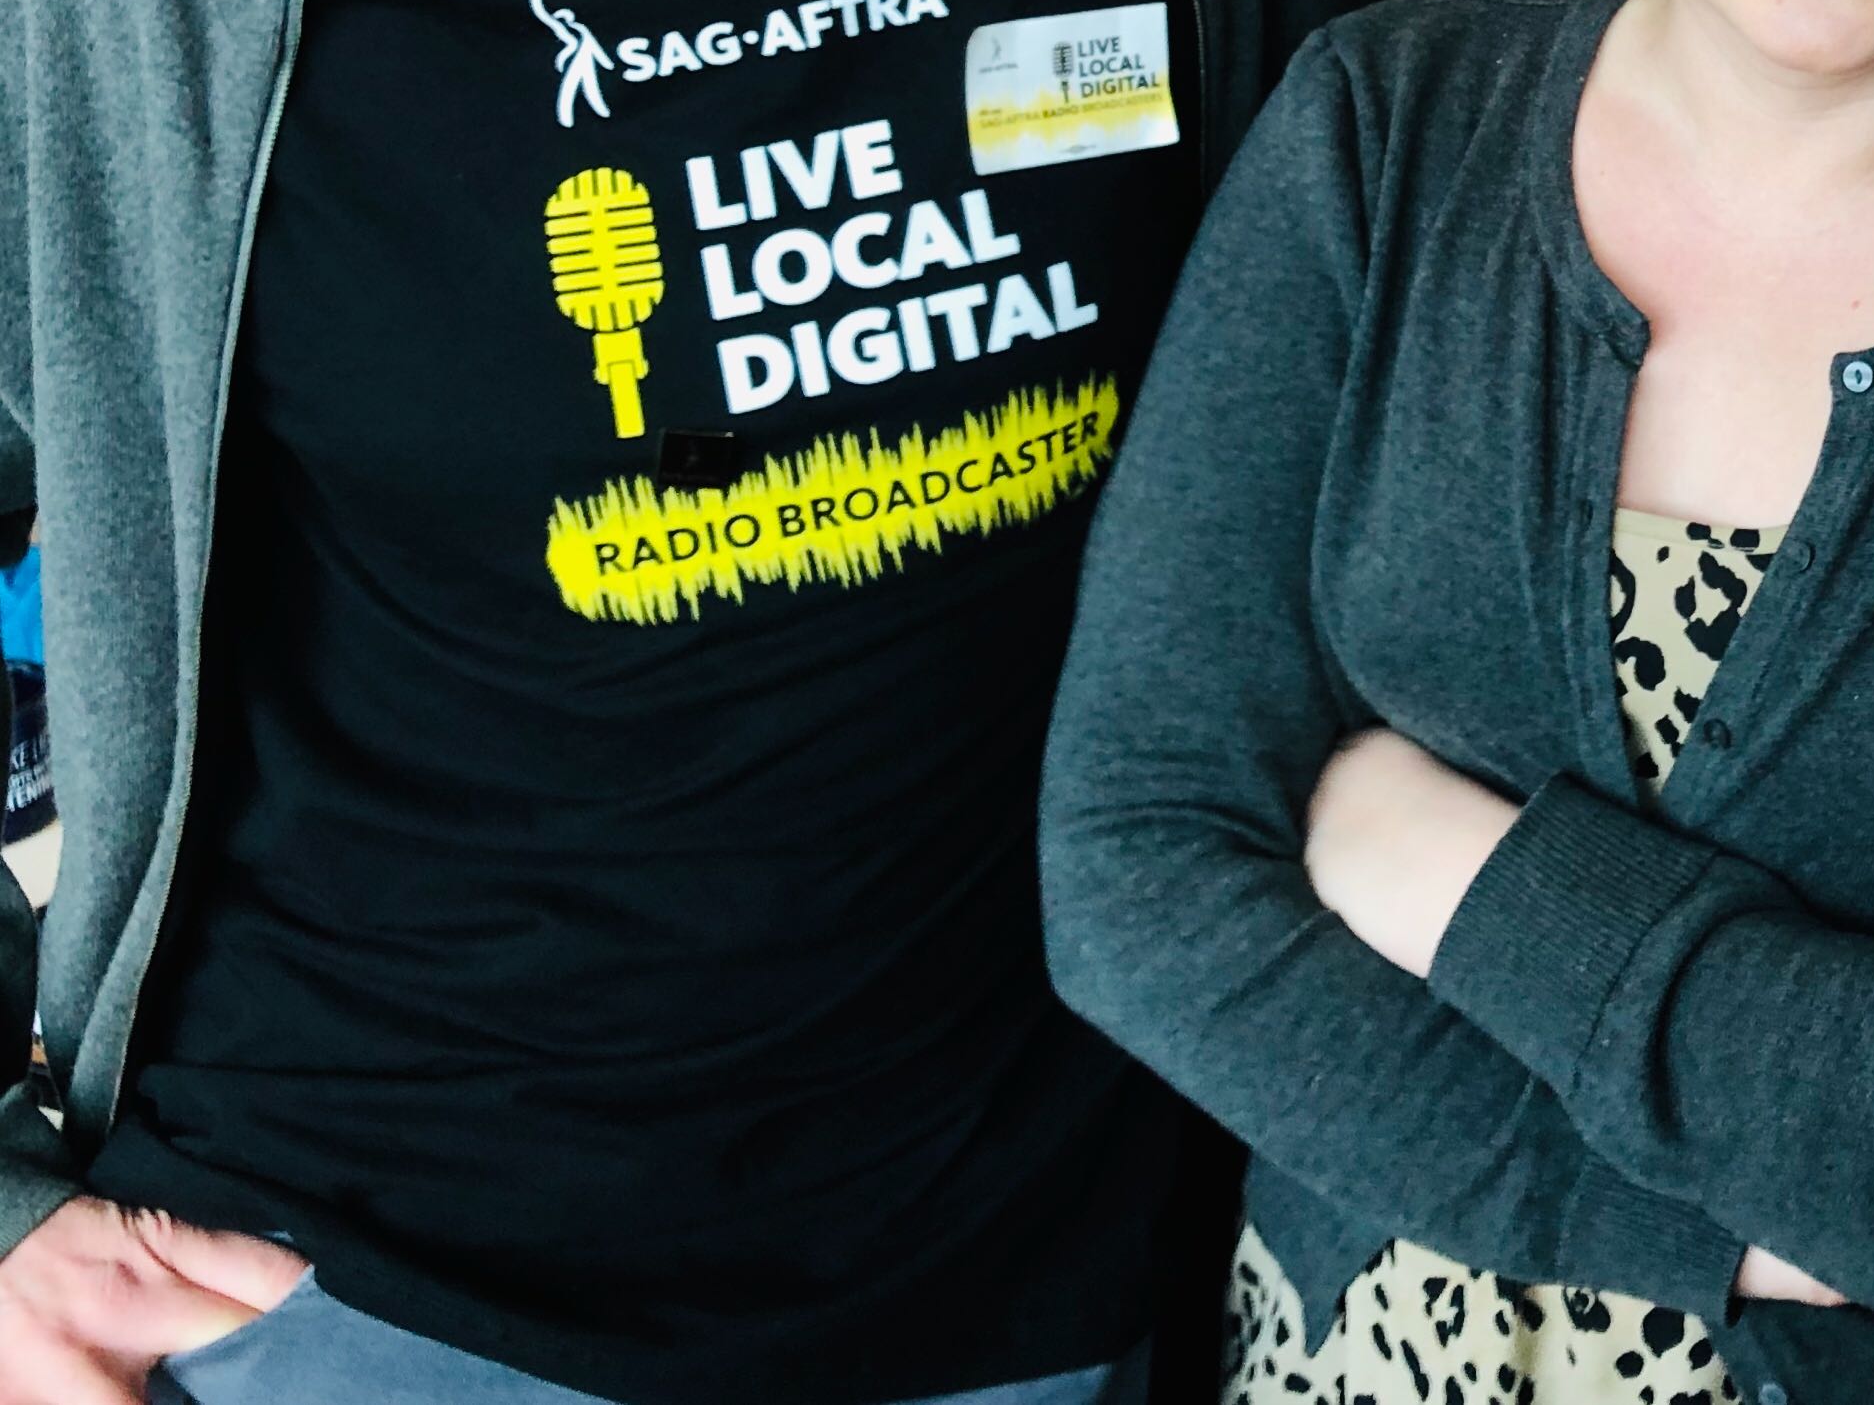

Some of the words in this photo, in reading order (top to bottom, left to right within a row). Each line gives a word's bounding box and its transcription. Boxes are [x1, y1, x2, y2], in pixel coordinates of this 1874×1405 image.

[1076, 36, 1122, 58] LIVE
[1078, 54, 1145, 78] LOCAL
[1080, 72, 1161, 99] DIGITAL
[686, 120, 902, 230] LIVE
[701, 189, 1021, 320] LOCAL
[717, 261, 1098, 414] DIGITAL
[594, 512, 761, 576] RADIO
[778, 413, 1100, 538] BROADCASTER
